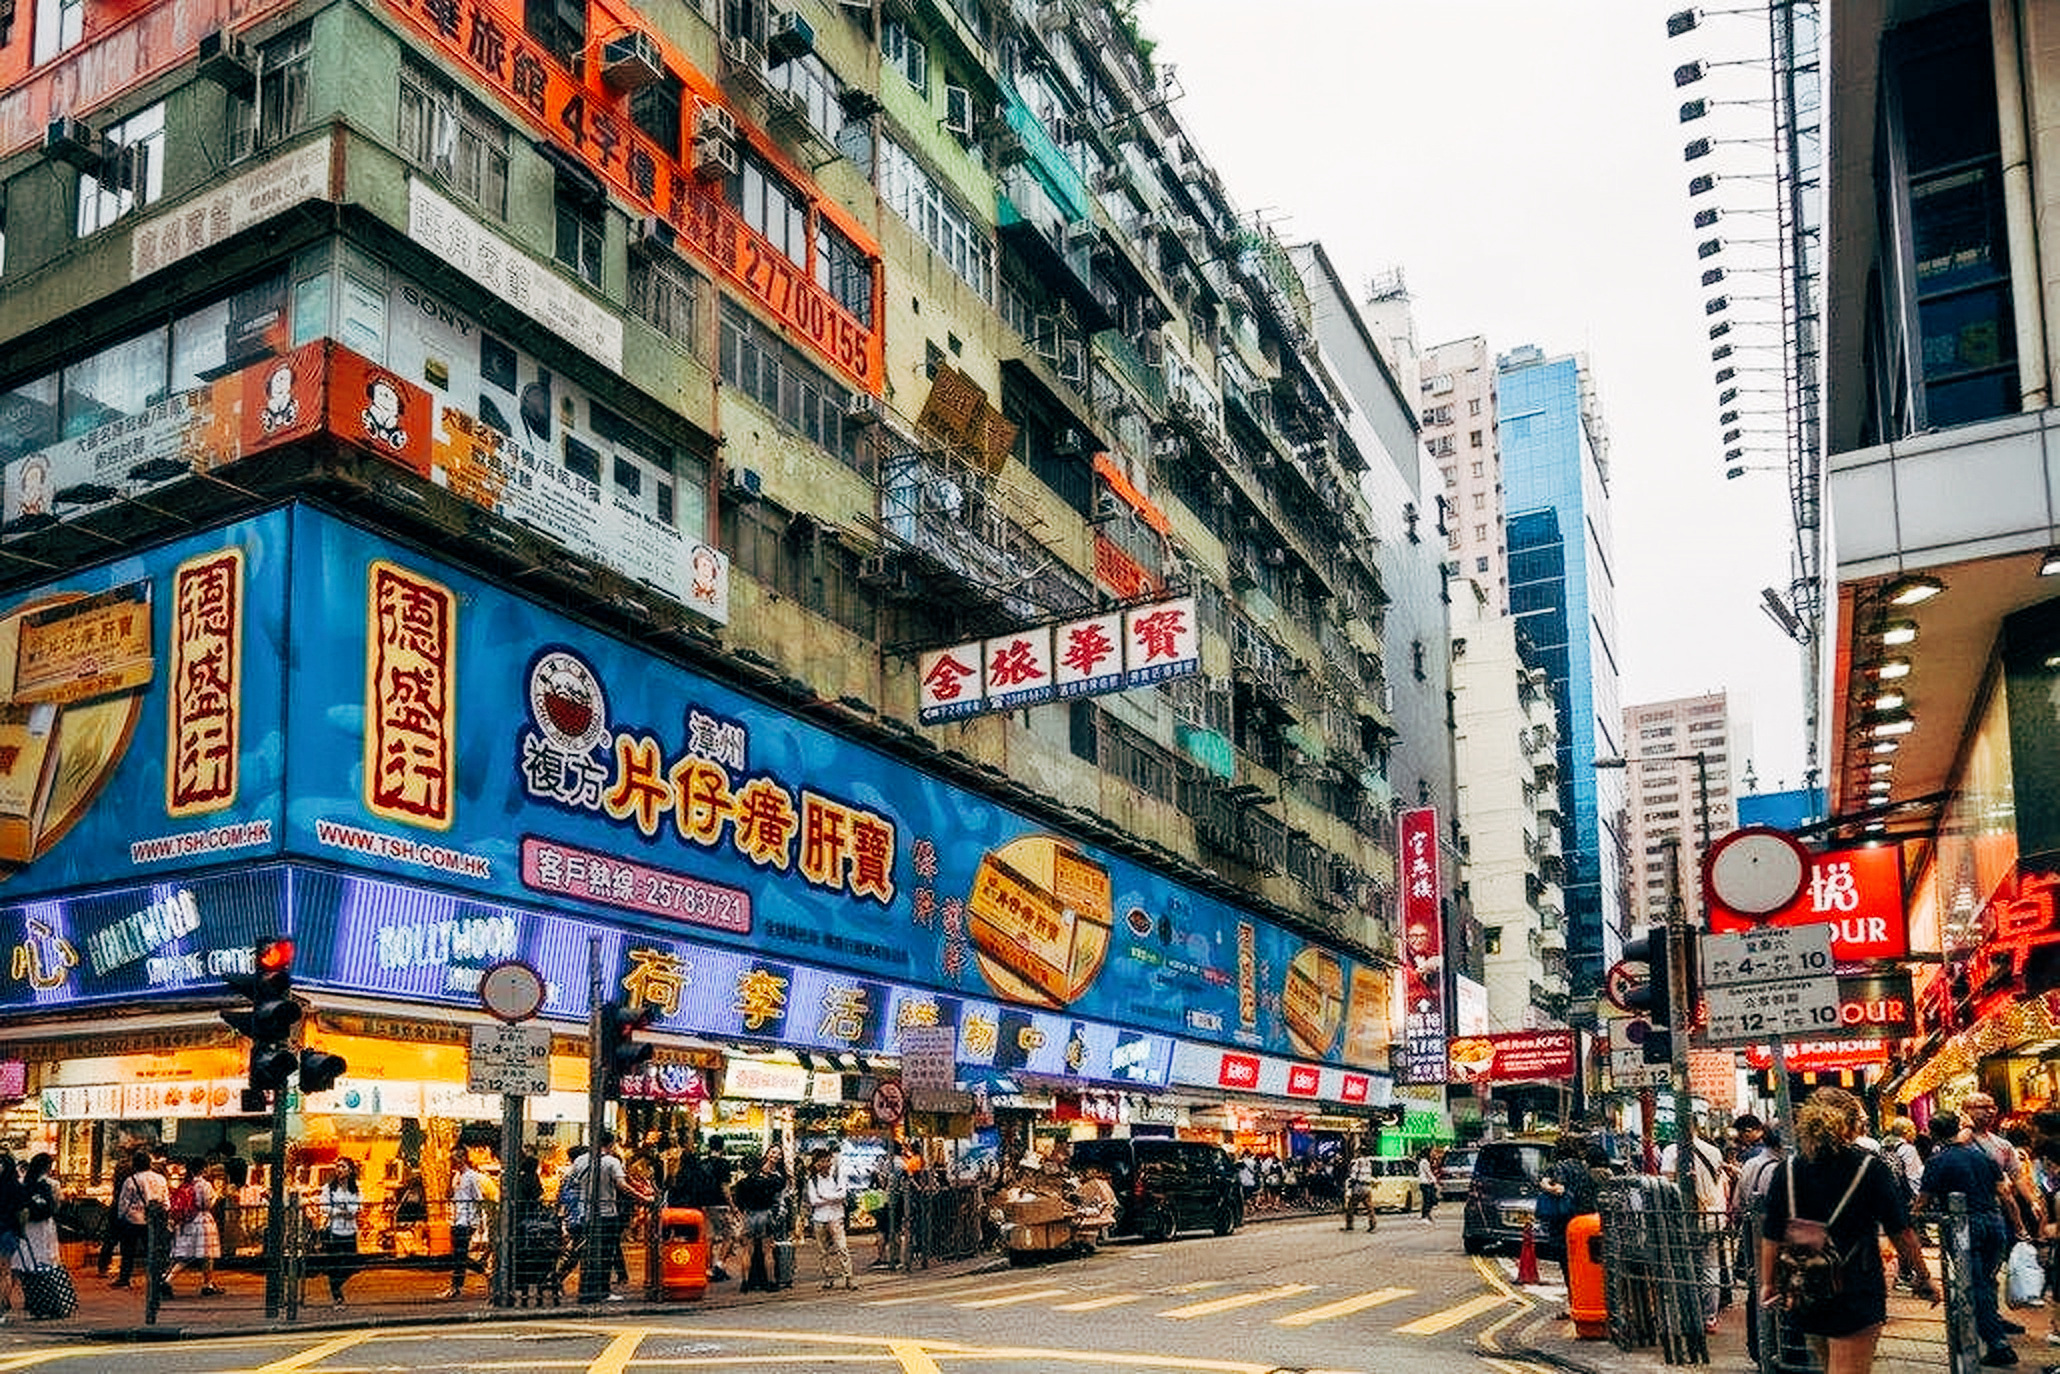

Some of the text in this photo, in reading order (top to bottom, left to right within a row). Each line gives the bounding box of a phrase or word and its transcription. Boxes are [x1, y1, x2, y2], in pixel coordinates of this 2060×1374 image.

[400, 284, 472, 338] SONY
[746, 237, 868, 378] 27700155
[522, 733, 609, 811] 複方
[131, 820, 272, 863] WWW.TSH.COM.HK
[316, 821, 491, 878] WWW.TSH.COM.HK
[11, 917, 79, 991] 心
[1801, 951, 1827, 969] 10
[1809, 1006, 1837, 1025] 10
[531, 1045, 546, 1057] 10
[1800, 1040, 1882, 1055] BONJOUR
[1651, 1070, 1669, 1084] 12
